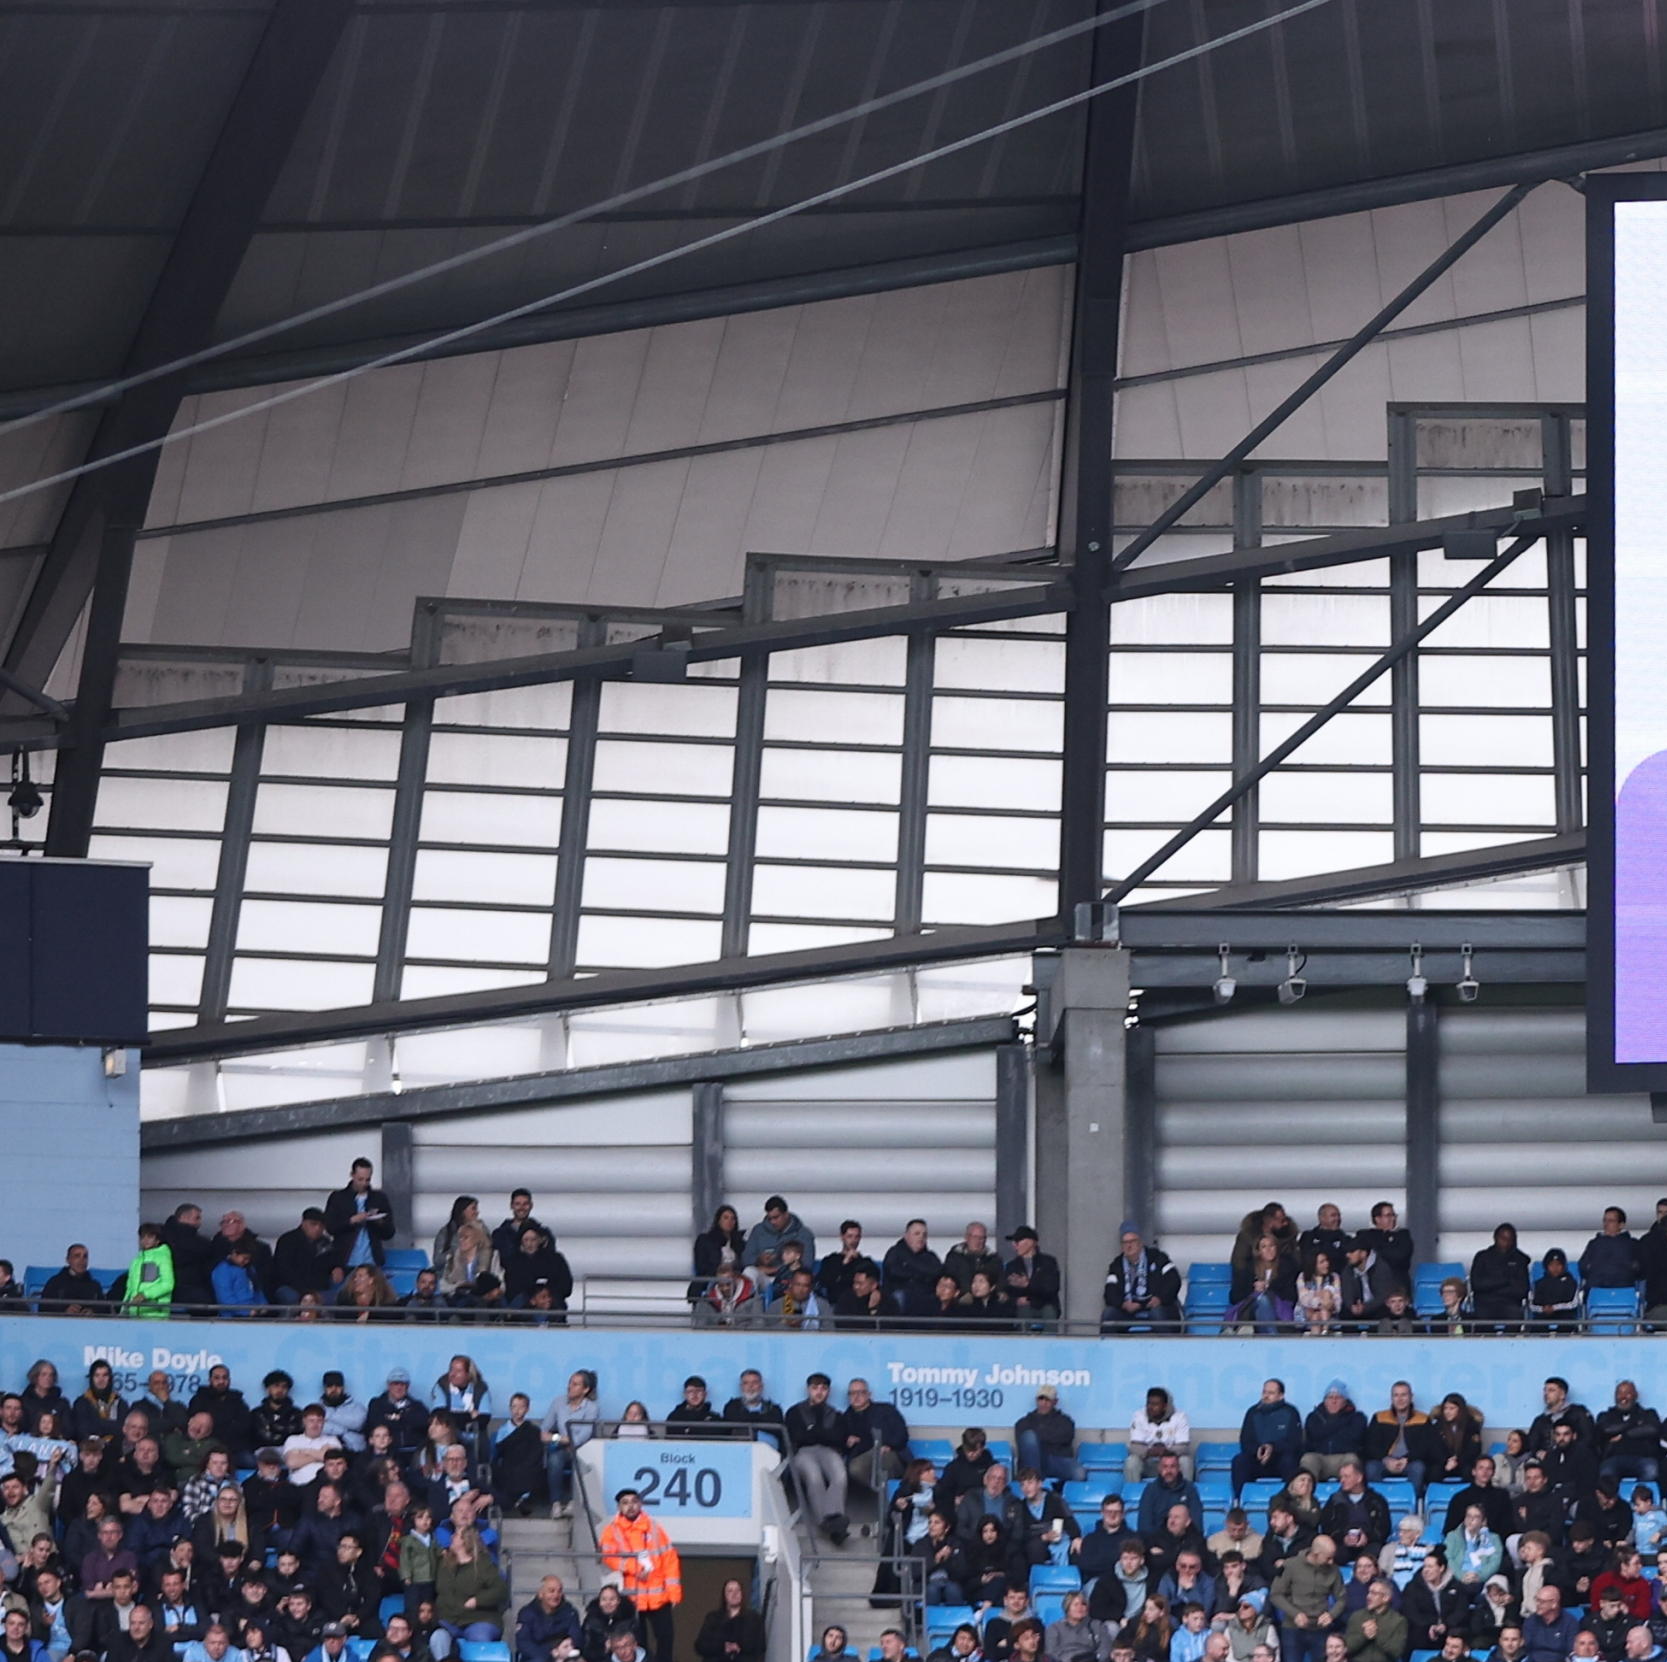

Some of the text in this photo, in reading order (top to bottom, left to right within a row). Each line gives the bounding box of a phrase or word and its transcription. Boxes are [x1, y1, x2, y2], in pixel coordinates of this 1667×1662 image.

[84, 1345, 223, 1374] Mike Doyle
[888, 1362, 1091, 1389] Tommy Johnson
[661, 1452, 696, 1464] Block
[634, 1468, 721, 1507] 240
